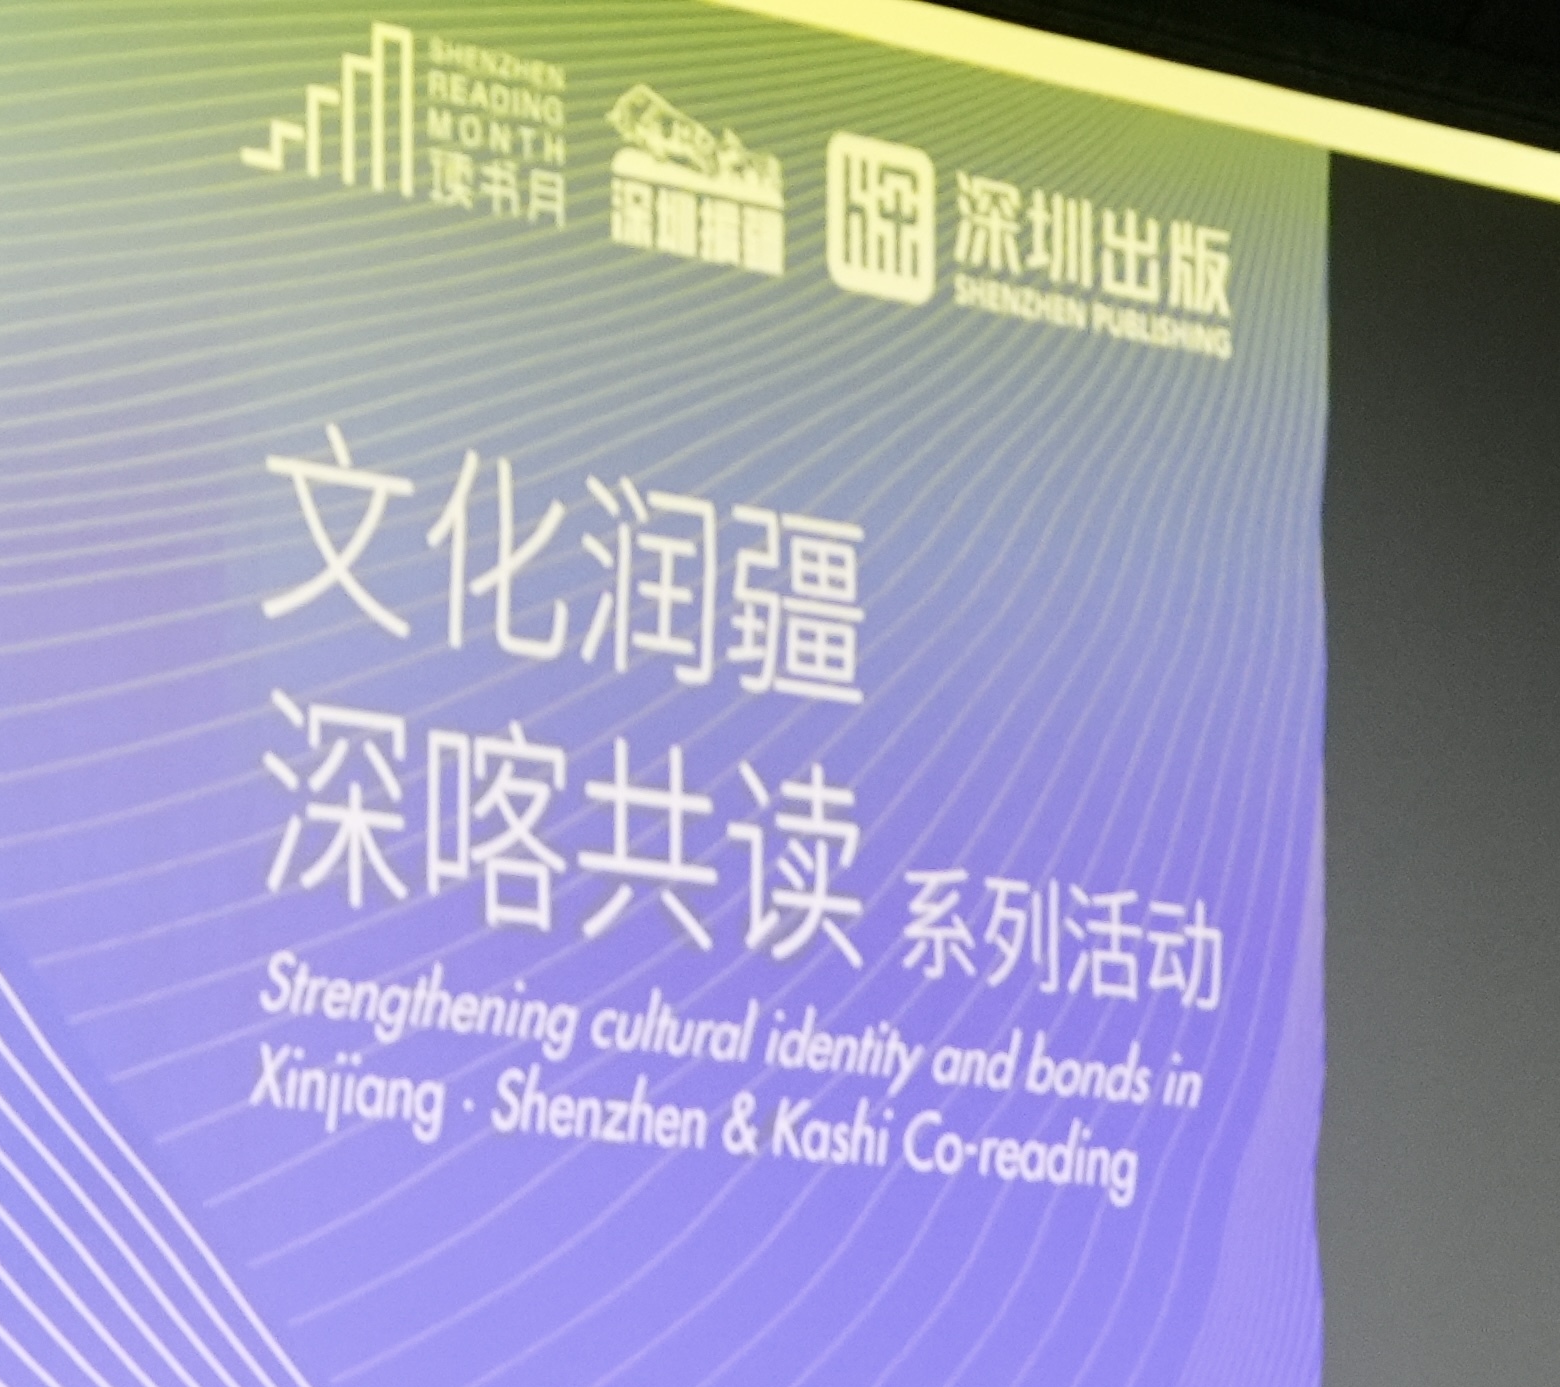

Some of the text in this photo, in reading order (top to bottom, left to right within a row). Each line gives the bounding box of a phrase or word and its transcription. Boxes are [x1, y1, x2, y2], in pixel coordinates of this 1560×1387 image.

[428, 69, 564, 128] READING
[428, 107, 565, 166] MONTH
[430, 148, 565, 231] 读书月
[954, 169, 1230, 318] 深圳出版
[954, 273, 1231, 362] SHENZHEN PUBLISHING
[261, 422, 864, 705] 文化润疆
[262, 689, 1224, 1010] 深喀共读 系列活动
[259, 949, 1203, 1109] Strengthening cultural identity and bonds in
[249, 1041, 445, 1144] Xinjiang
[491, 1062, 708, 1149] Shenzhen
[722, 1089, 758, 1156] &
[771, 1096, 890, 1166] Kashi
[903, 1109, 1139, 1208] Co-reading
